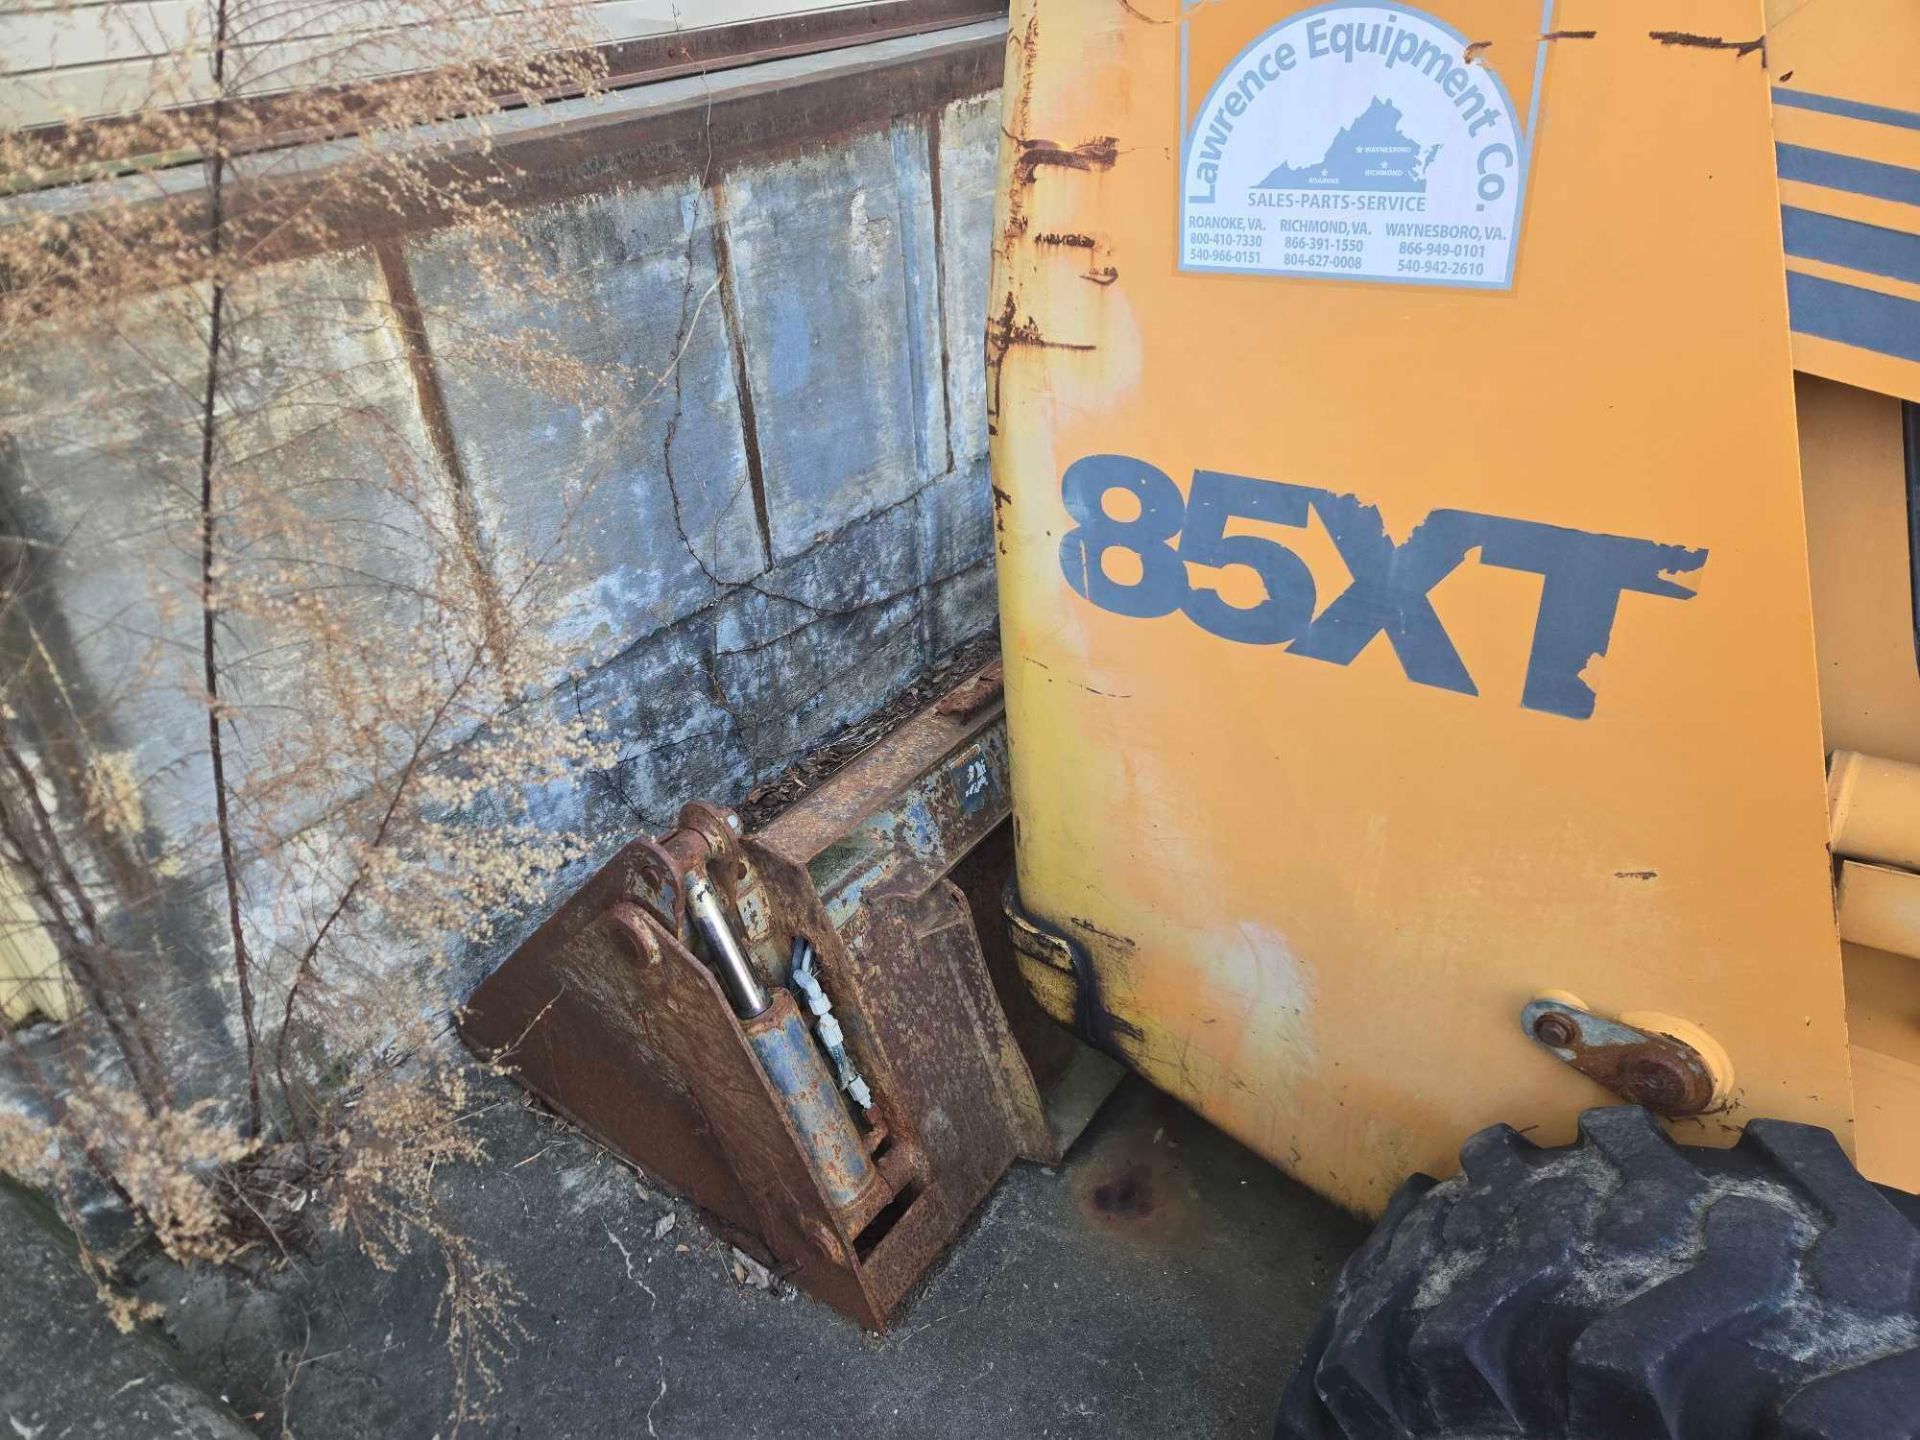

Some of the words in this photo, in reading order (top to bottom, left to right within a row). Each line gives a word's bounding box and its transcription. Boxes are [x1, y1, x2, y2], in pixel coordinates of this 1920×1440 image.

[1188, 43, 1297, 204] Lawrence
[1306, 14, 1501, 138] Equipment
[1475, 142, 1514, 212] Co.
[1190, 232, 1263, 247] 800-410-7330
[1284, 236, 1364, 252] 866-391-1550
[1189, 248, 1261, 264] 540-966-0151
[1399, 241, 1486, 258] 866-949-0101
[1283, 253, 1362, 270] 804-627-0008
[1397, 259, 1485, 276] 540-942-2610
[1058, 454, 1710, 721] 85XT
